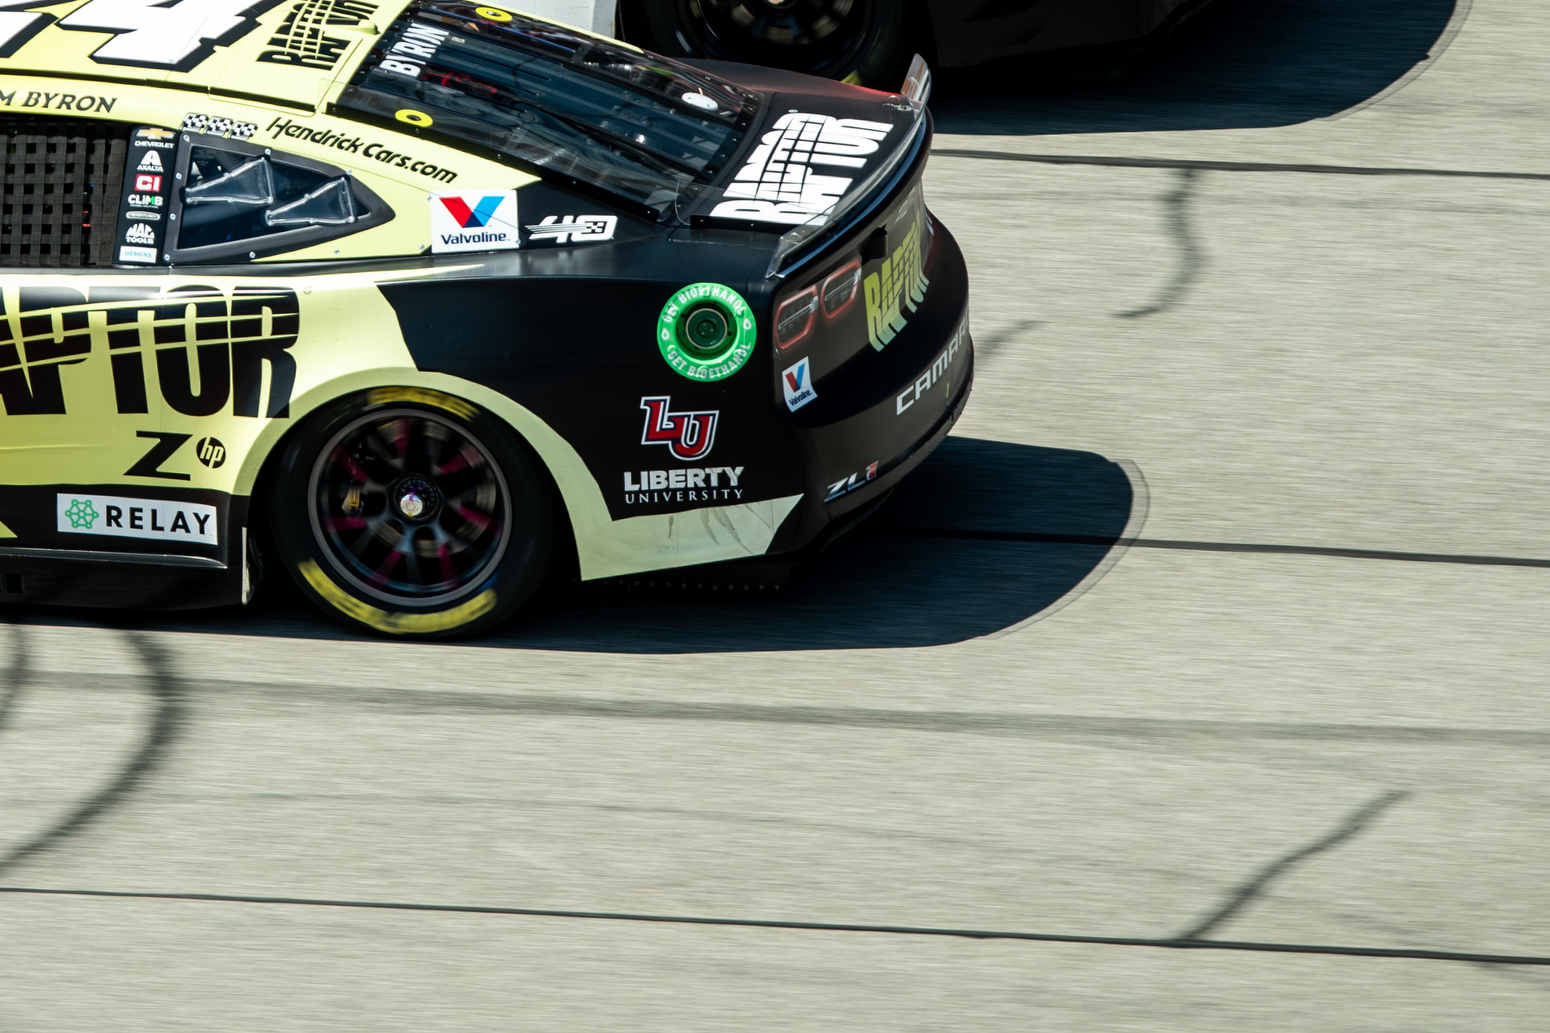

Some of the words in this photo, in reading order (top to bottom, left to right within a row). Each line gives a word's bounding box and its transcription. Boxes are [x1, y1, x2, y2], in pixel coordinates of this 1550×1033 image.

[379, 23, 449, 77] BYRON
[21, 91, 118, 113] BYRON
[135, 140, 174, 148] CHEVROLET
[137, 164, 164, 172] AXALTA
[126, 223, 155, 238] MAC
[126, 236, 155, 244] TOOLS
[440, 232, 506, 245] Valvoline
[124, 250, 152, 258] SIEMENS
[788, 388, 812, 407] Valvoline
[123, 430, 193, 481] Z
[199, 436, 225, 469] hp
[624, 467, 744, 491] LIBERTY
[625, 489, 743, 504] UNIVERSITY
[106, 504, 210, 536] RELAY
